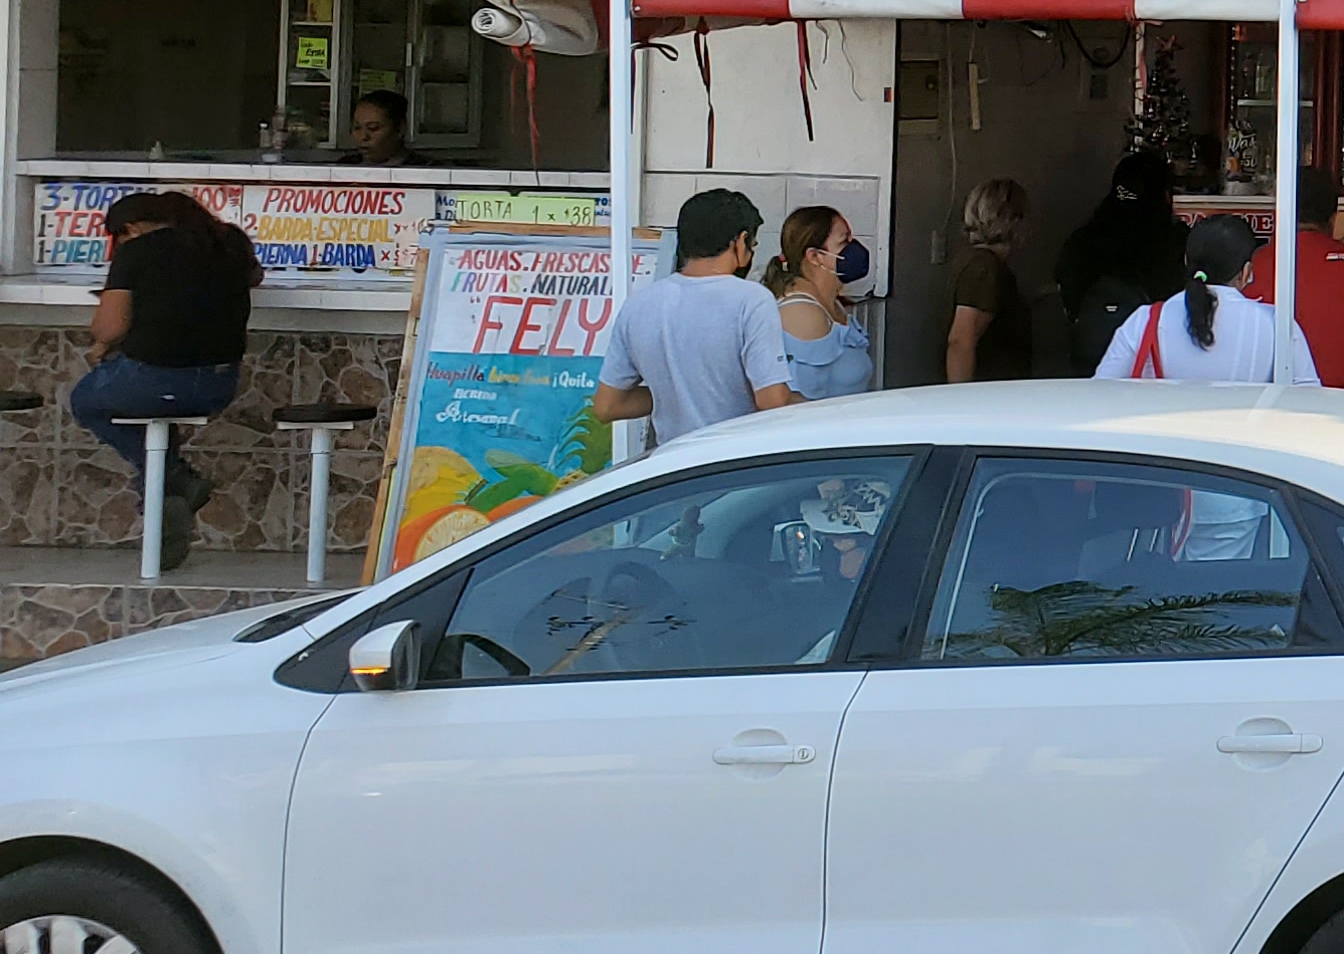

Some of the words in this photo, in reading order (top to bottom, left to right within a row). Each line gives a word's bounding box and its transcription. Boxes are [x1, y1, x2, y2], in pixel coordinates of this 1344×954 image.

[262, 187, 405, 215] PROMOCIONES
[457, 199, 513, 221] TORTA
[532, 205, 539, 224] 1
